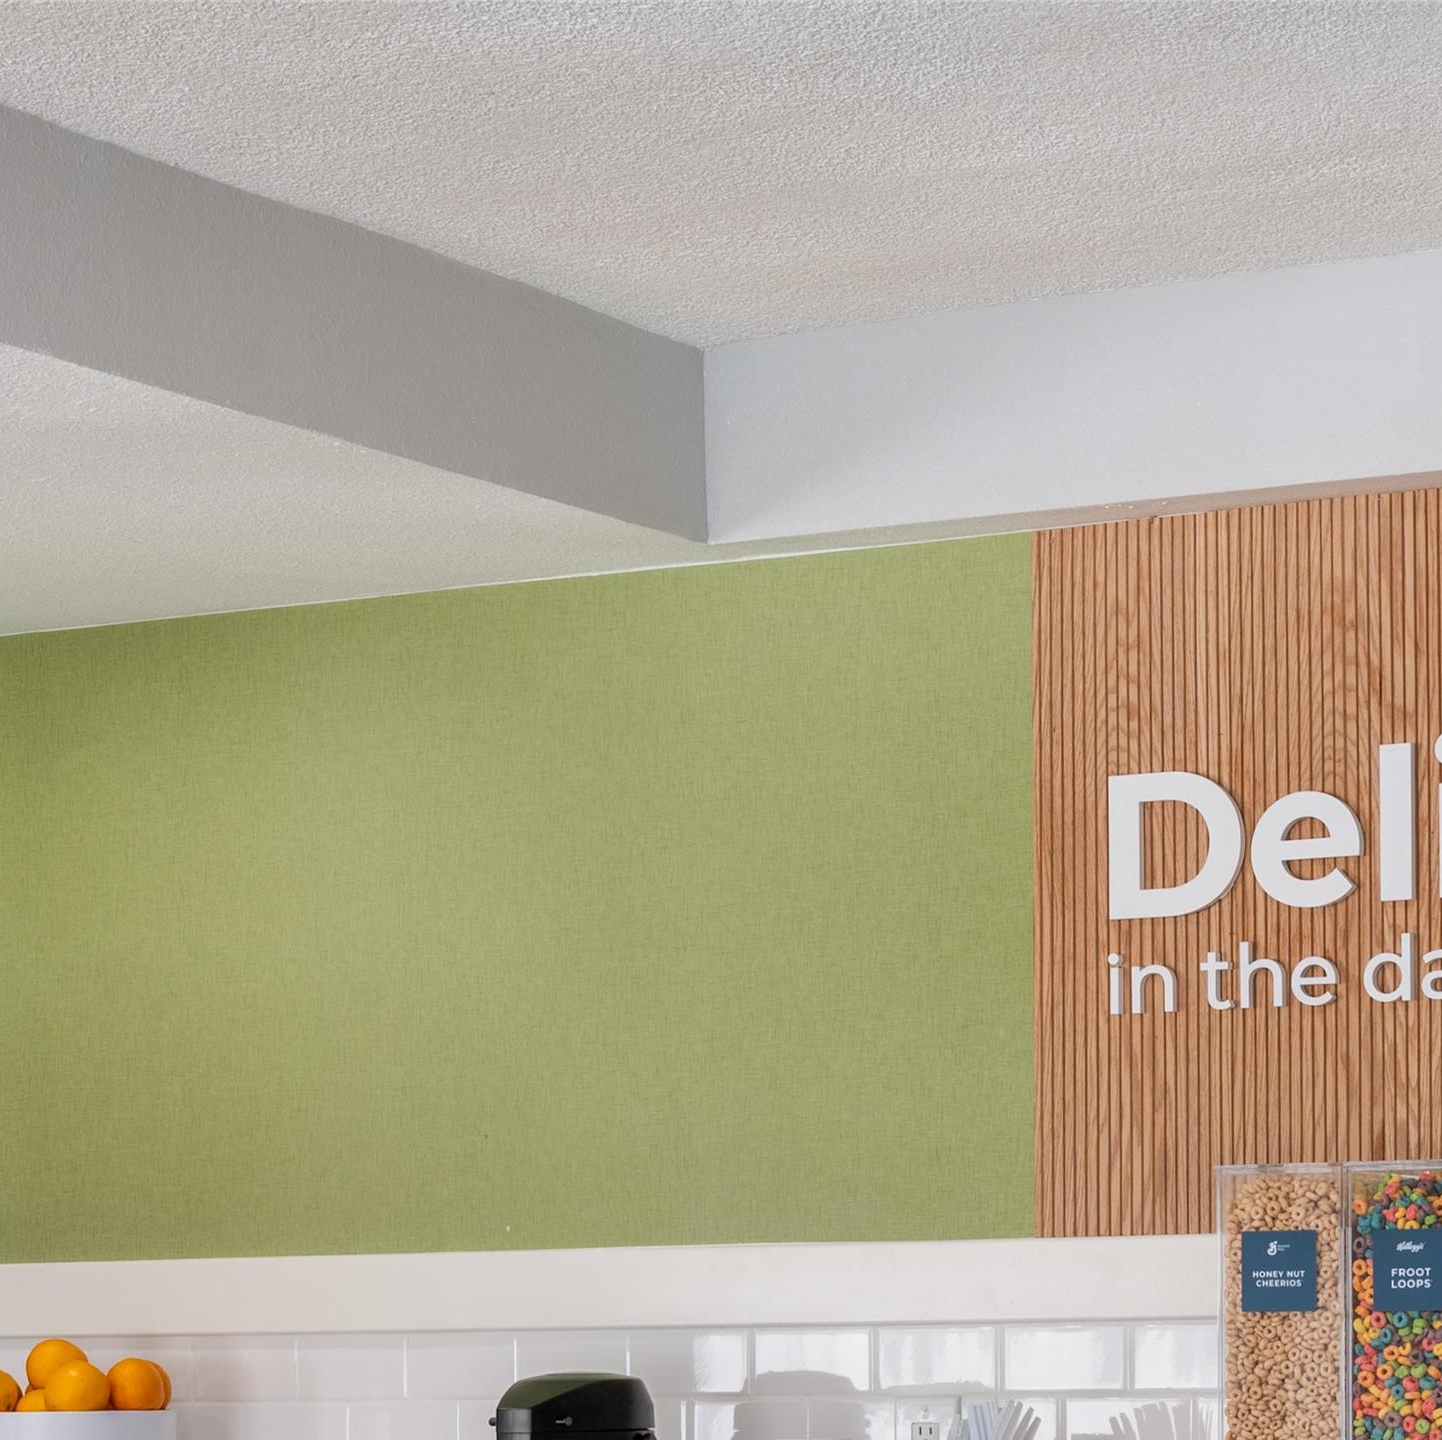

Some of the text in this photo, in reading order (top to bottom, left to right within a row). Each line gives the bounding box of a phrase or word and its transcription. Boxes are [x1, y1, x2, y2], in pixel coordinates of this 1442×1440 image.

[1107, 953, 1179, 1015] in
[1200, 941, 1341, 1011] the
[1252, 1270, 1305, 1278] HONEY NUT
[1391, 1267, 1431, 1277] FROOT
[1255, 1279, 1302, 1288] CHEERIOS
[1391, 1279, 1431, 1289] LOOPS
